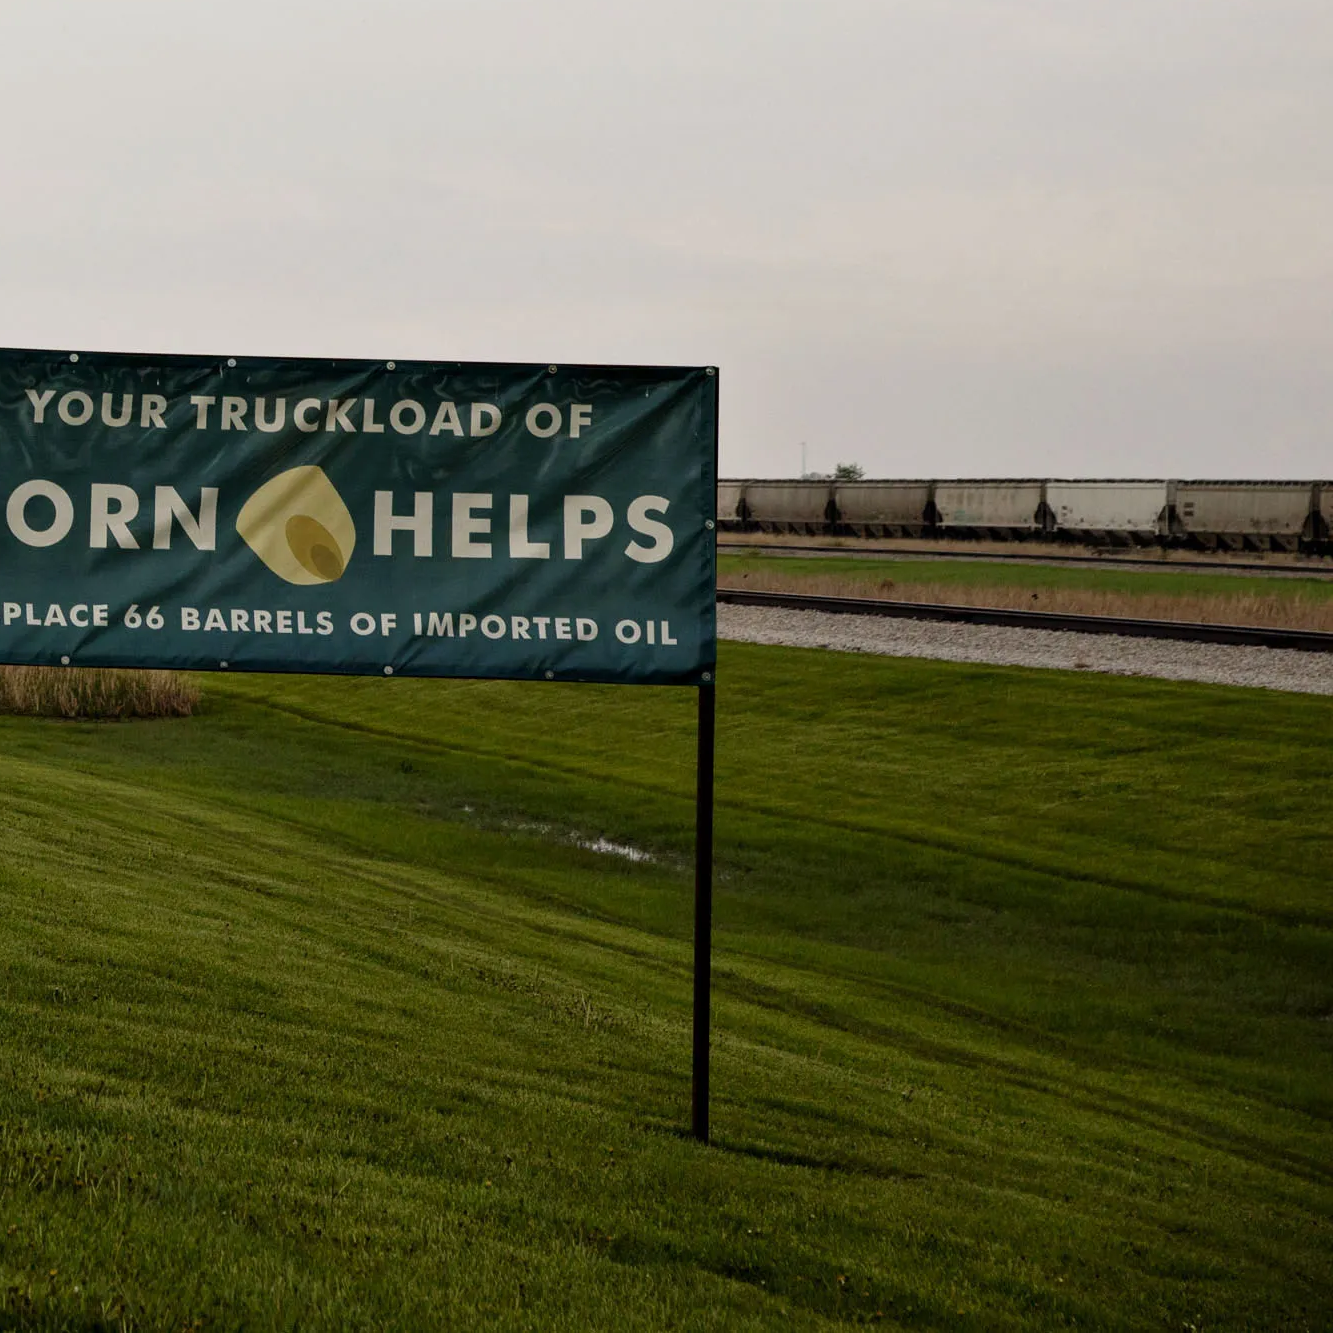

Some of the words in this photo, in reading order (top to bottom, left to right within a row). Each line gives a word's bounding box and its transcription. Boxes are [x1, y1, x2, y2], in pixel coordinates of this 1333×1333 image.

[25, 390, 167, 428] YOUR
[191, 396, 502, 437] TRUCKLOAD
[526, 403, 592, 438] OF
[373, 490, 674, 563] HELPS
[124, 604, 165, 630] 66
[181, 607, 333, 634] BARRELS
[350, 612, 397, 636] OF
[414, 612, 599, 641] IMPORTED
[615, 620, 677, 645] OIL
